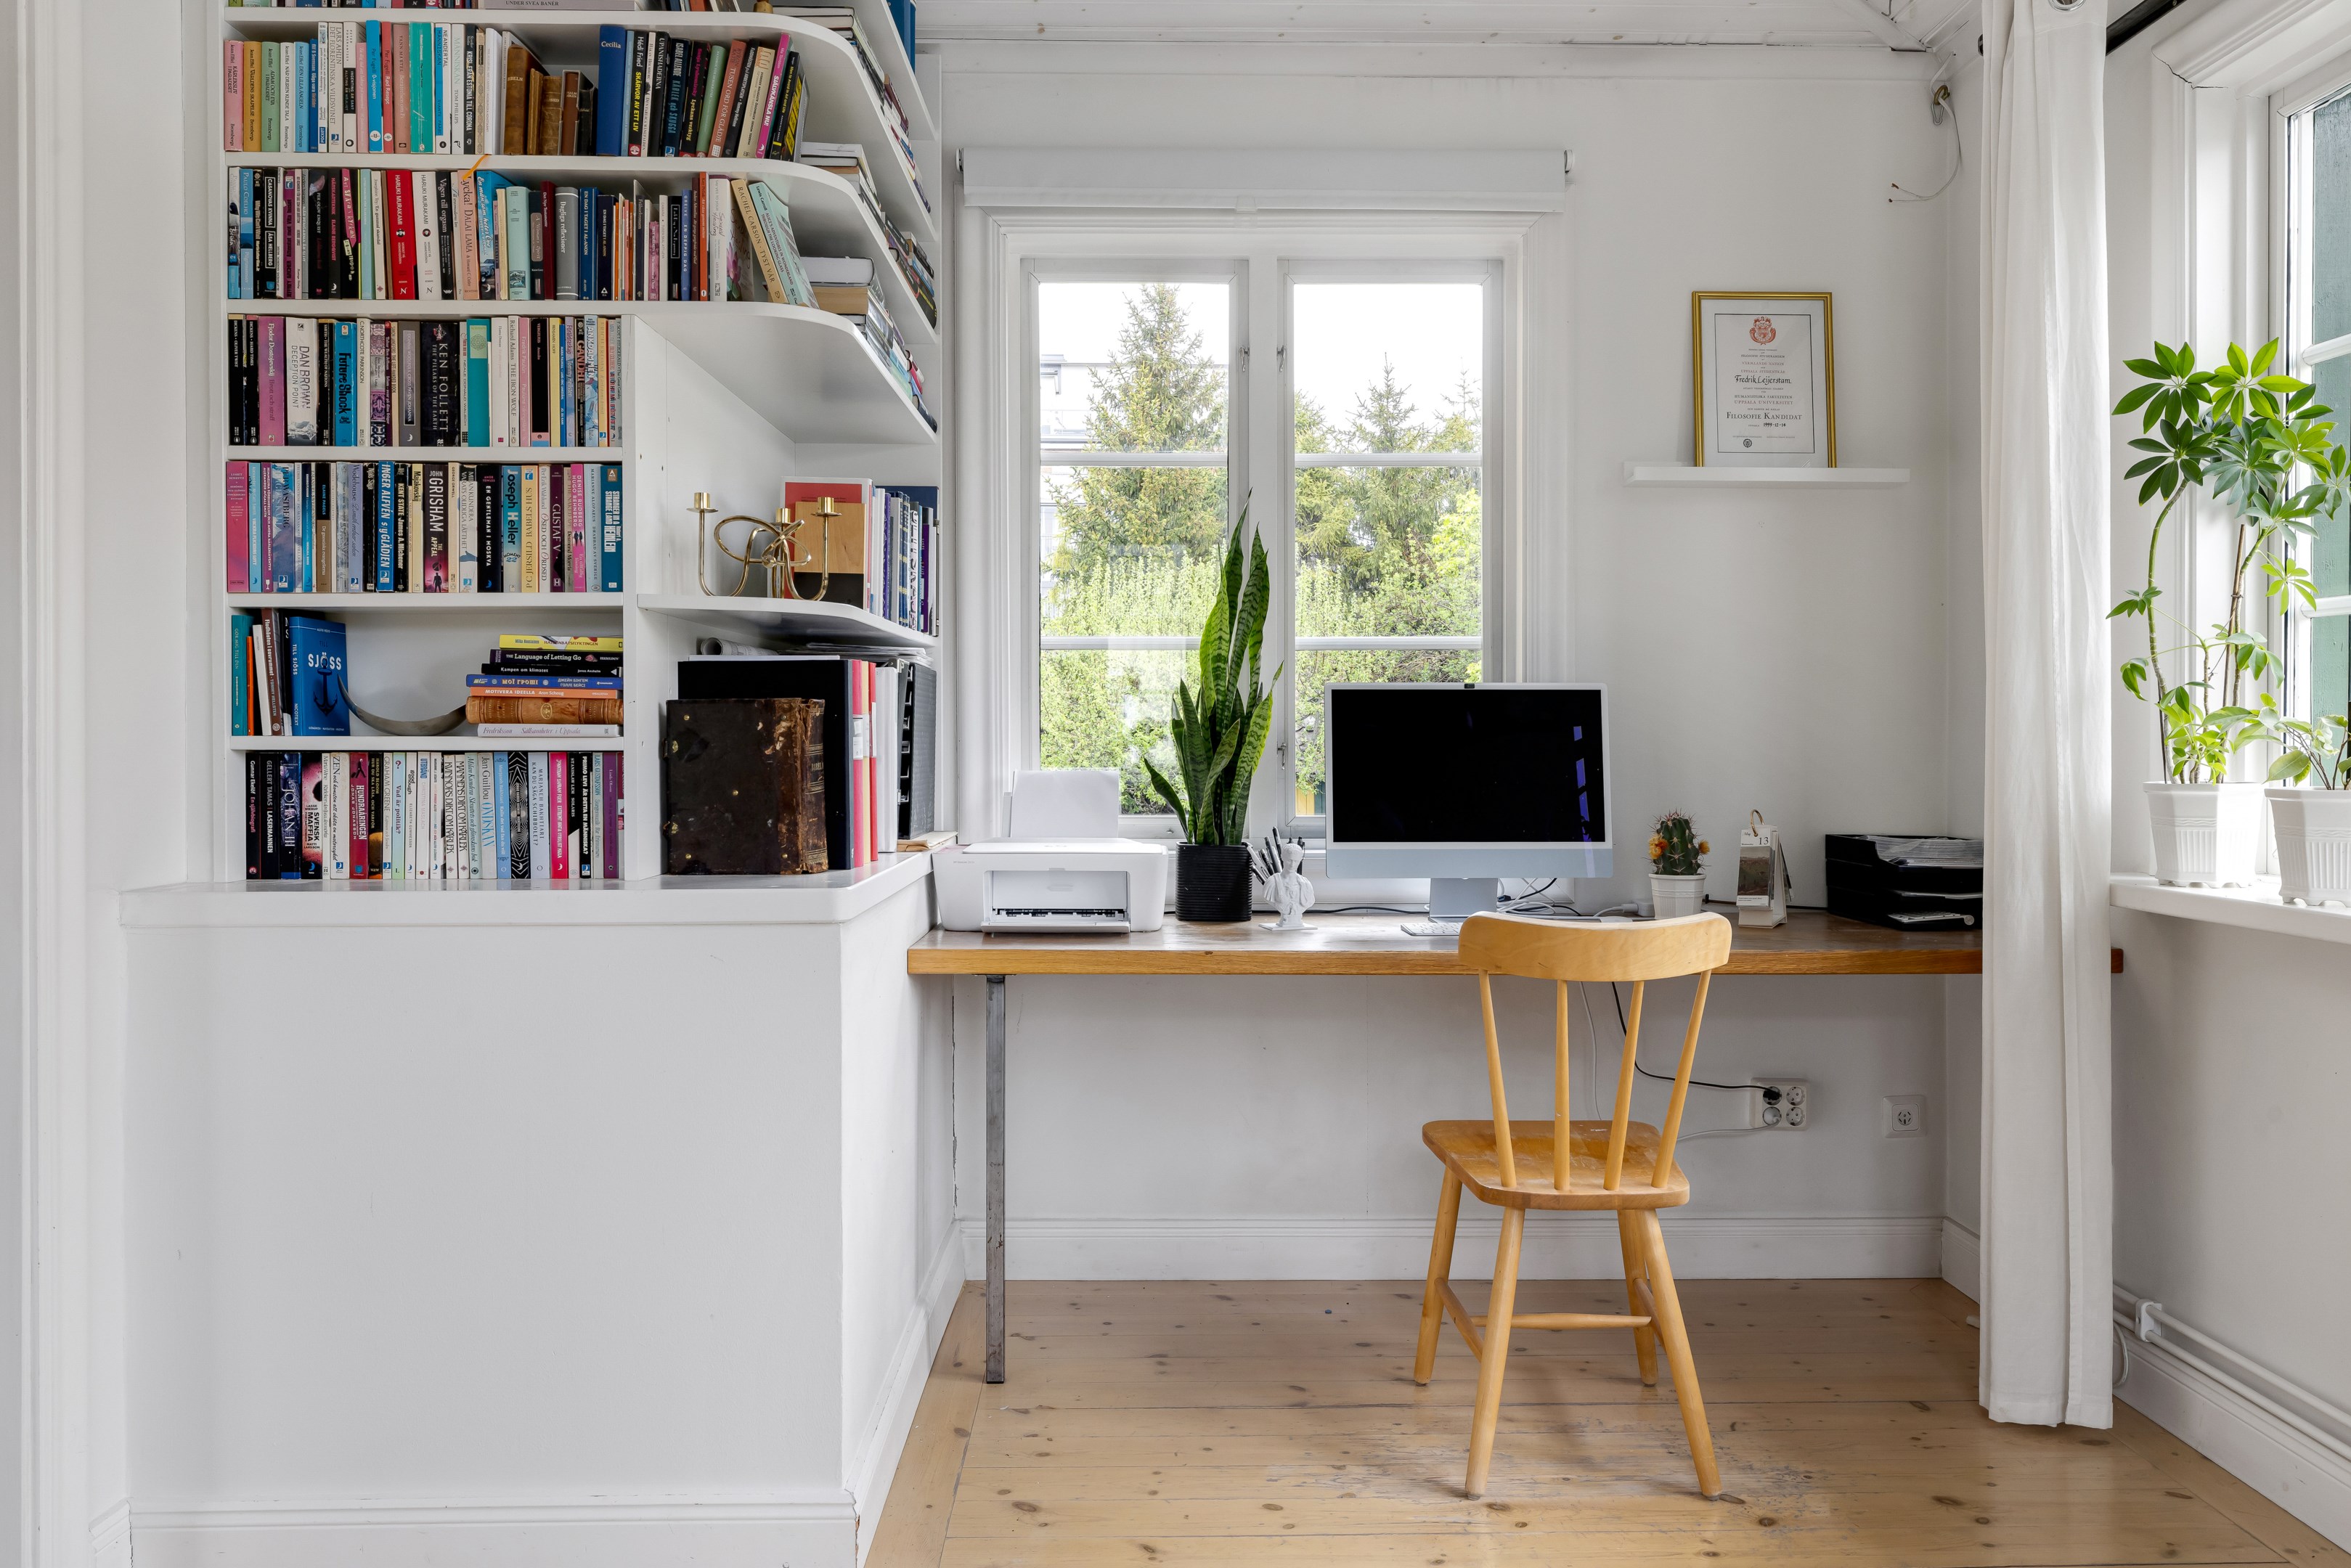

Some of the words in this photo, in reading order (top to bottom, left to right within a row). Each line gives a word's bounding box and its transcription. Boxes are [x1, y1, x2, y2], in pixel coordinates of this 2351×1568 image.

[675, 42, 684, 57] ISABEL
[655, 38, 665, 89] UPANISHADERNA
[672, 58, 682, 77] ALLENDE
[671, 80, 681, 101] KÄRLEK
[728, 68, 736, 89] TUSEN
[724, 89, 733, 104] ORD
[765, 75, 780, 115] SJÄLVKÄNSLA
[689, 99, 698, 121] Lyckans
[686, 121, 696, 142] verktyg
[715, 118, 725, 142] GLÄDJE
[437, 178, 447, 197] Vägen
[439, 210, 447, 232] orgasm
[464, 210, 473, 232] DALAI
[737, 187, 751, 215] RACHEL
[746, 216, 762, 244] CARSON
[759, 249, 769, 267] TYST
[766, 269, 776, 283] VÅR
[299, 346, 310, 368] DAN
[439, 343, 448, 369] KEN
[576, 340, 585, 382] GANDHI
[586, 326, 595, 379] ANKDAMMEN
[338, 352, 351, 383] Future
[1735, 375, 1758, 383] Fredrik
[299, 369, 311, 409] BROWN
[338, 384, 351, 415] Shock
[432, 385, 437, 393] OF
[439, 376, 449, 433] FOLLETT
[381, 464, 391, 488] INGER
[412, 470, 421, 502] Majakovskij
[505, 469, 519, 509] Joseph
[381, 489, 394, 519] ALFVÉN
[429, 478, 444, 532] GRISHAM
[508, 512, 519, 545] Heller
[553, 504, 561, 542] GUSTAF
[380, 534, 392, 568] GLÄDJEN
[554, 543, 561, 552] V
[308, 651, 342, 671] SJÖSS
[502, 676, 516, 685] МОЇ
[420, 758, 429, 779] UTBRÄND
[481, 756, 490, 769] Jan
[456, 761, 466, 796] MANNENS
[482, 770, 491, 799] Guillou
[356, 785, 367, 840] HUNDRAÅRINGEN
[457, 796, 466, 812] DIKT
[457, 812, 466, 825] OM
[481, 802, 494, 847] ONDSKAN
[458, 825, 468, 852] KÄRLEK
[1759, 836, 1769, 845] 13
